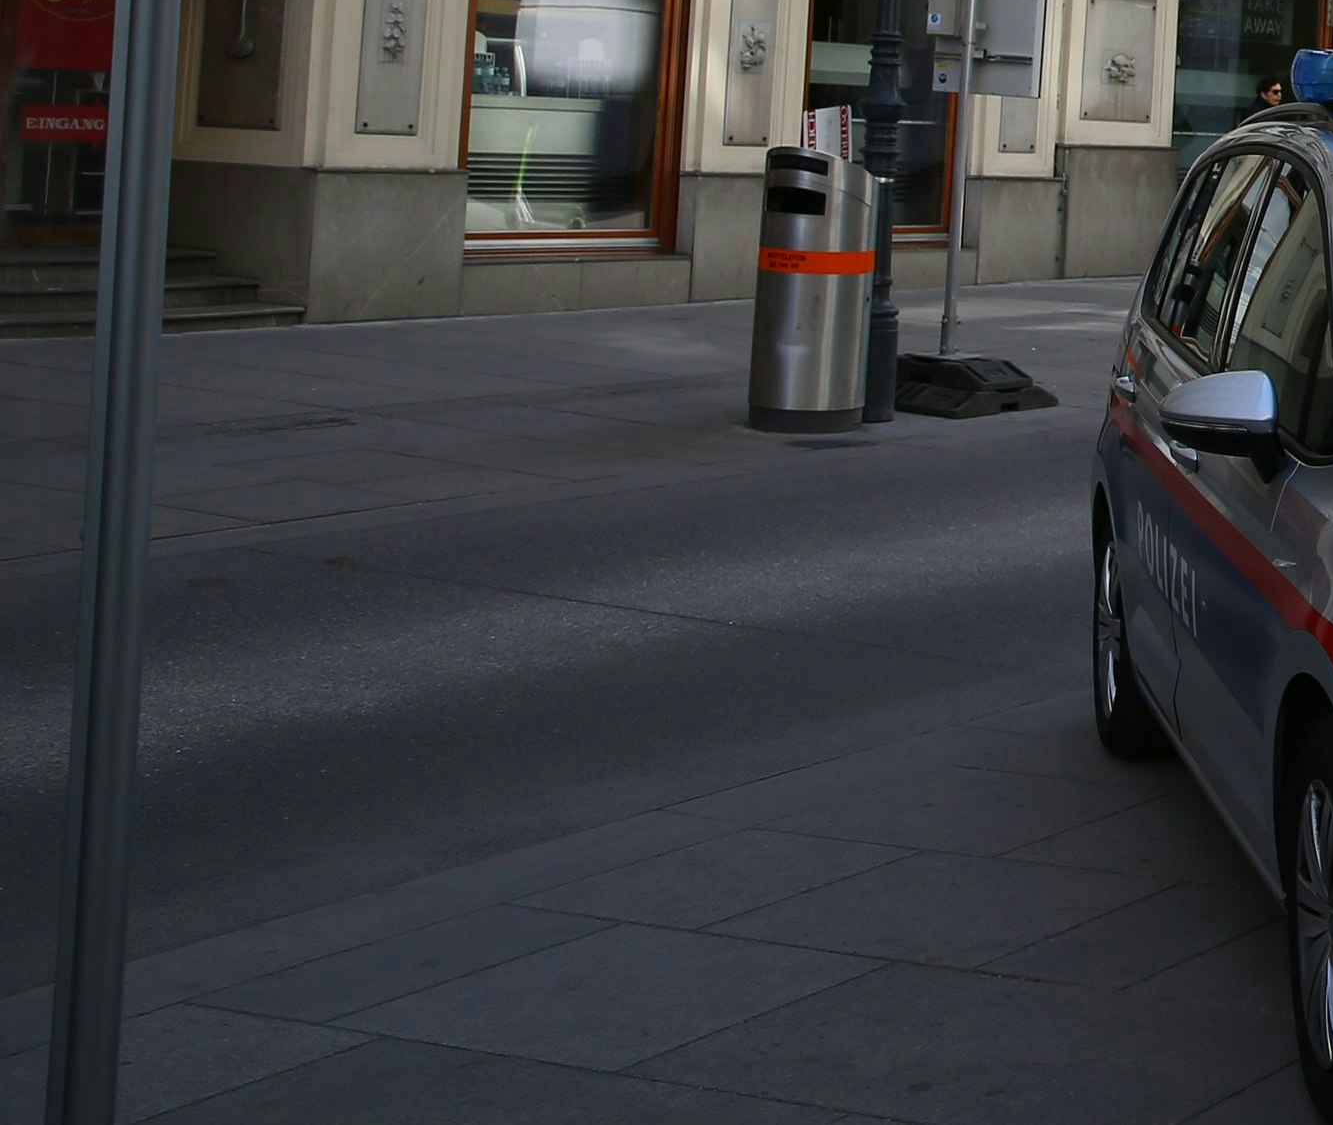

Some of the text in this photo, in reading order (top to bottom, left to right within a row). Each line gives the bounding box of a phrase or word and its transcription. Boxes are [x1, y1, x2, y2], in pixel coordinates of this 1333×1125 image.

[1244, 16, 1284, 36] AWAY
[26, 116, 105, 131] EINGANG
[1137, 499, 1197, 638] POLIZEI
